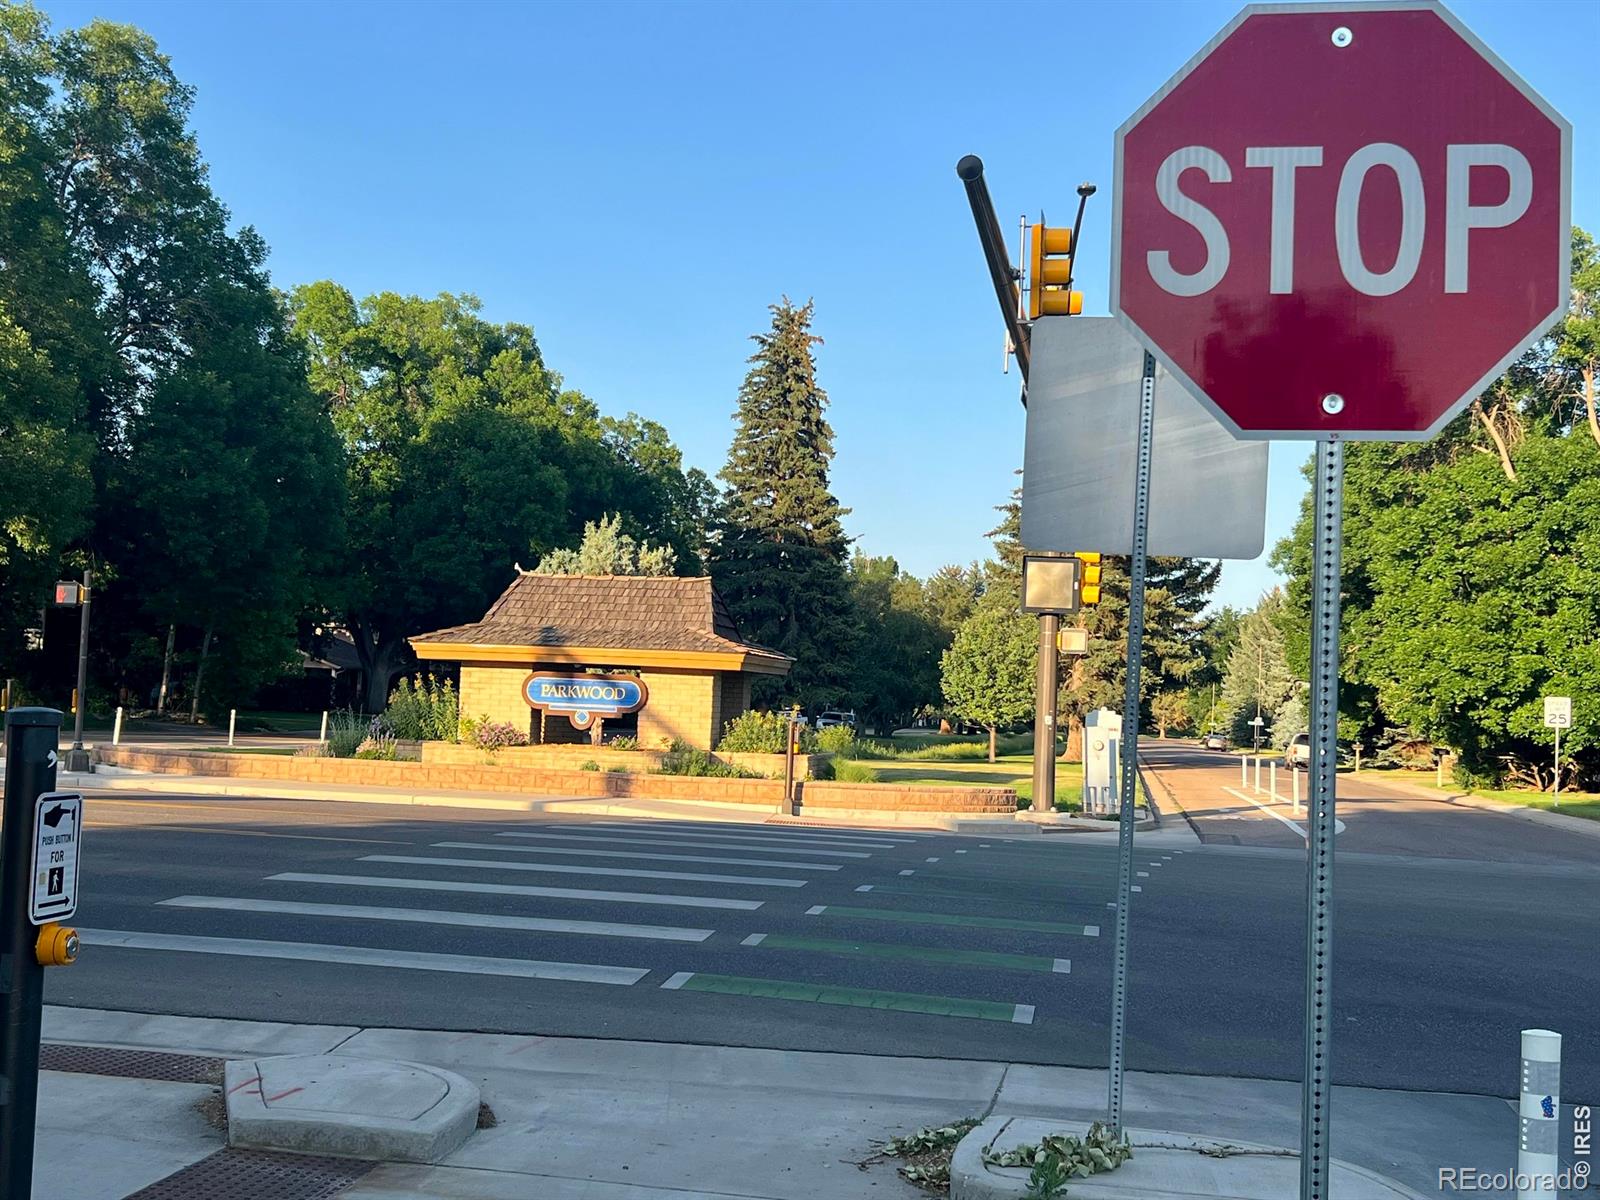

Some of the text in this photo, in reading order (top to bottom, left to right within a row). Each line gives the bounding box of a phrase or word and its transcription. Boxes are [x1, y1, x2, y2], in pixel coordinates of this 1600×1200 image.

[1146, 142, 1533, 297] STOP
[541, 684, 625, 700] PARKWOOD
[1548, 713, 1567, 724] 25
[42, 834, 71, 846] PUSH BUTTON
[50, 850, 64, 863] FOR
